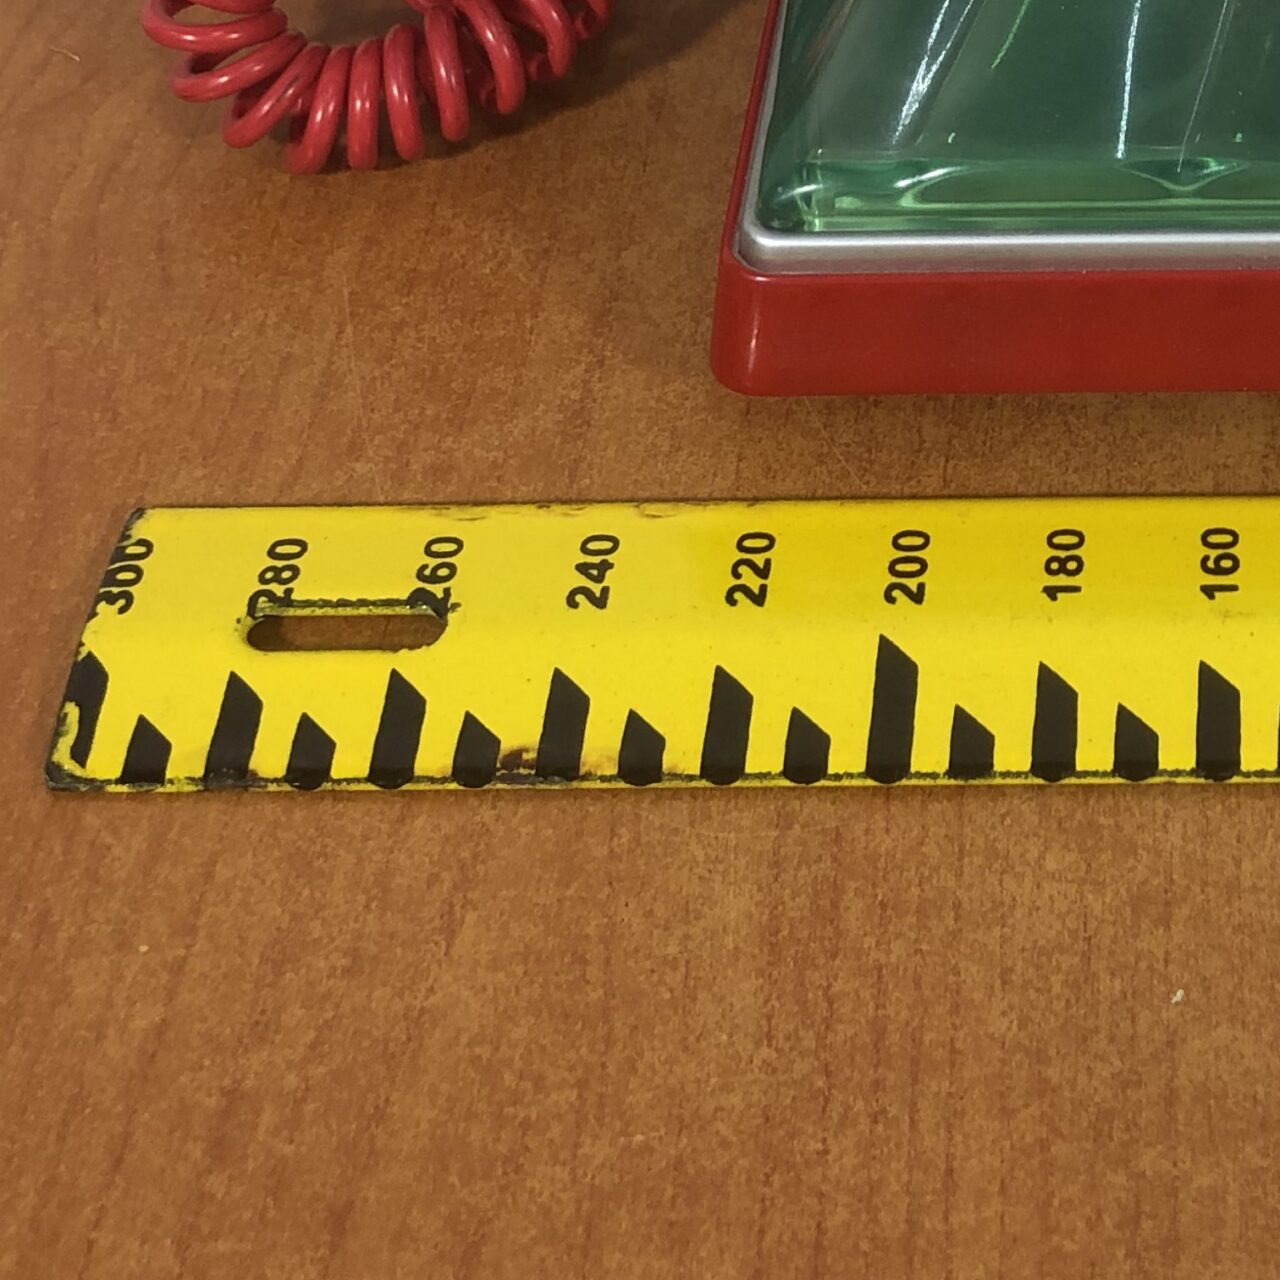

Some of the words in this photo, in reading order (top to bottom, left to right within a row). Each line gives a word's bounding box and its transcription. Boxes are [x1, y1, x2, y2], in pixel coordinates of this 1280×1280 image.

[246, 537, 309, 620] 280
[406, 534, 465, 617] 260
[565, 533, 621, 611] 240
[724, 530, 777, 608] 220
[883, 528, 932, 606] 200
[1040, 527, 1086, 602] 180
[1199, 526, 1241, 601] 160
